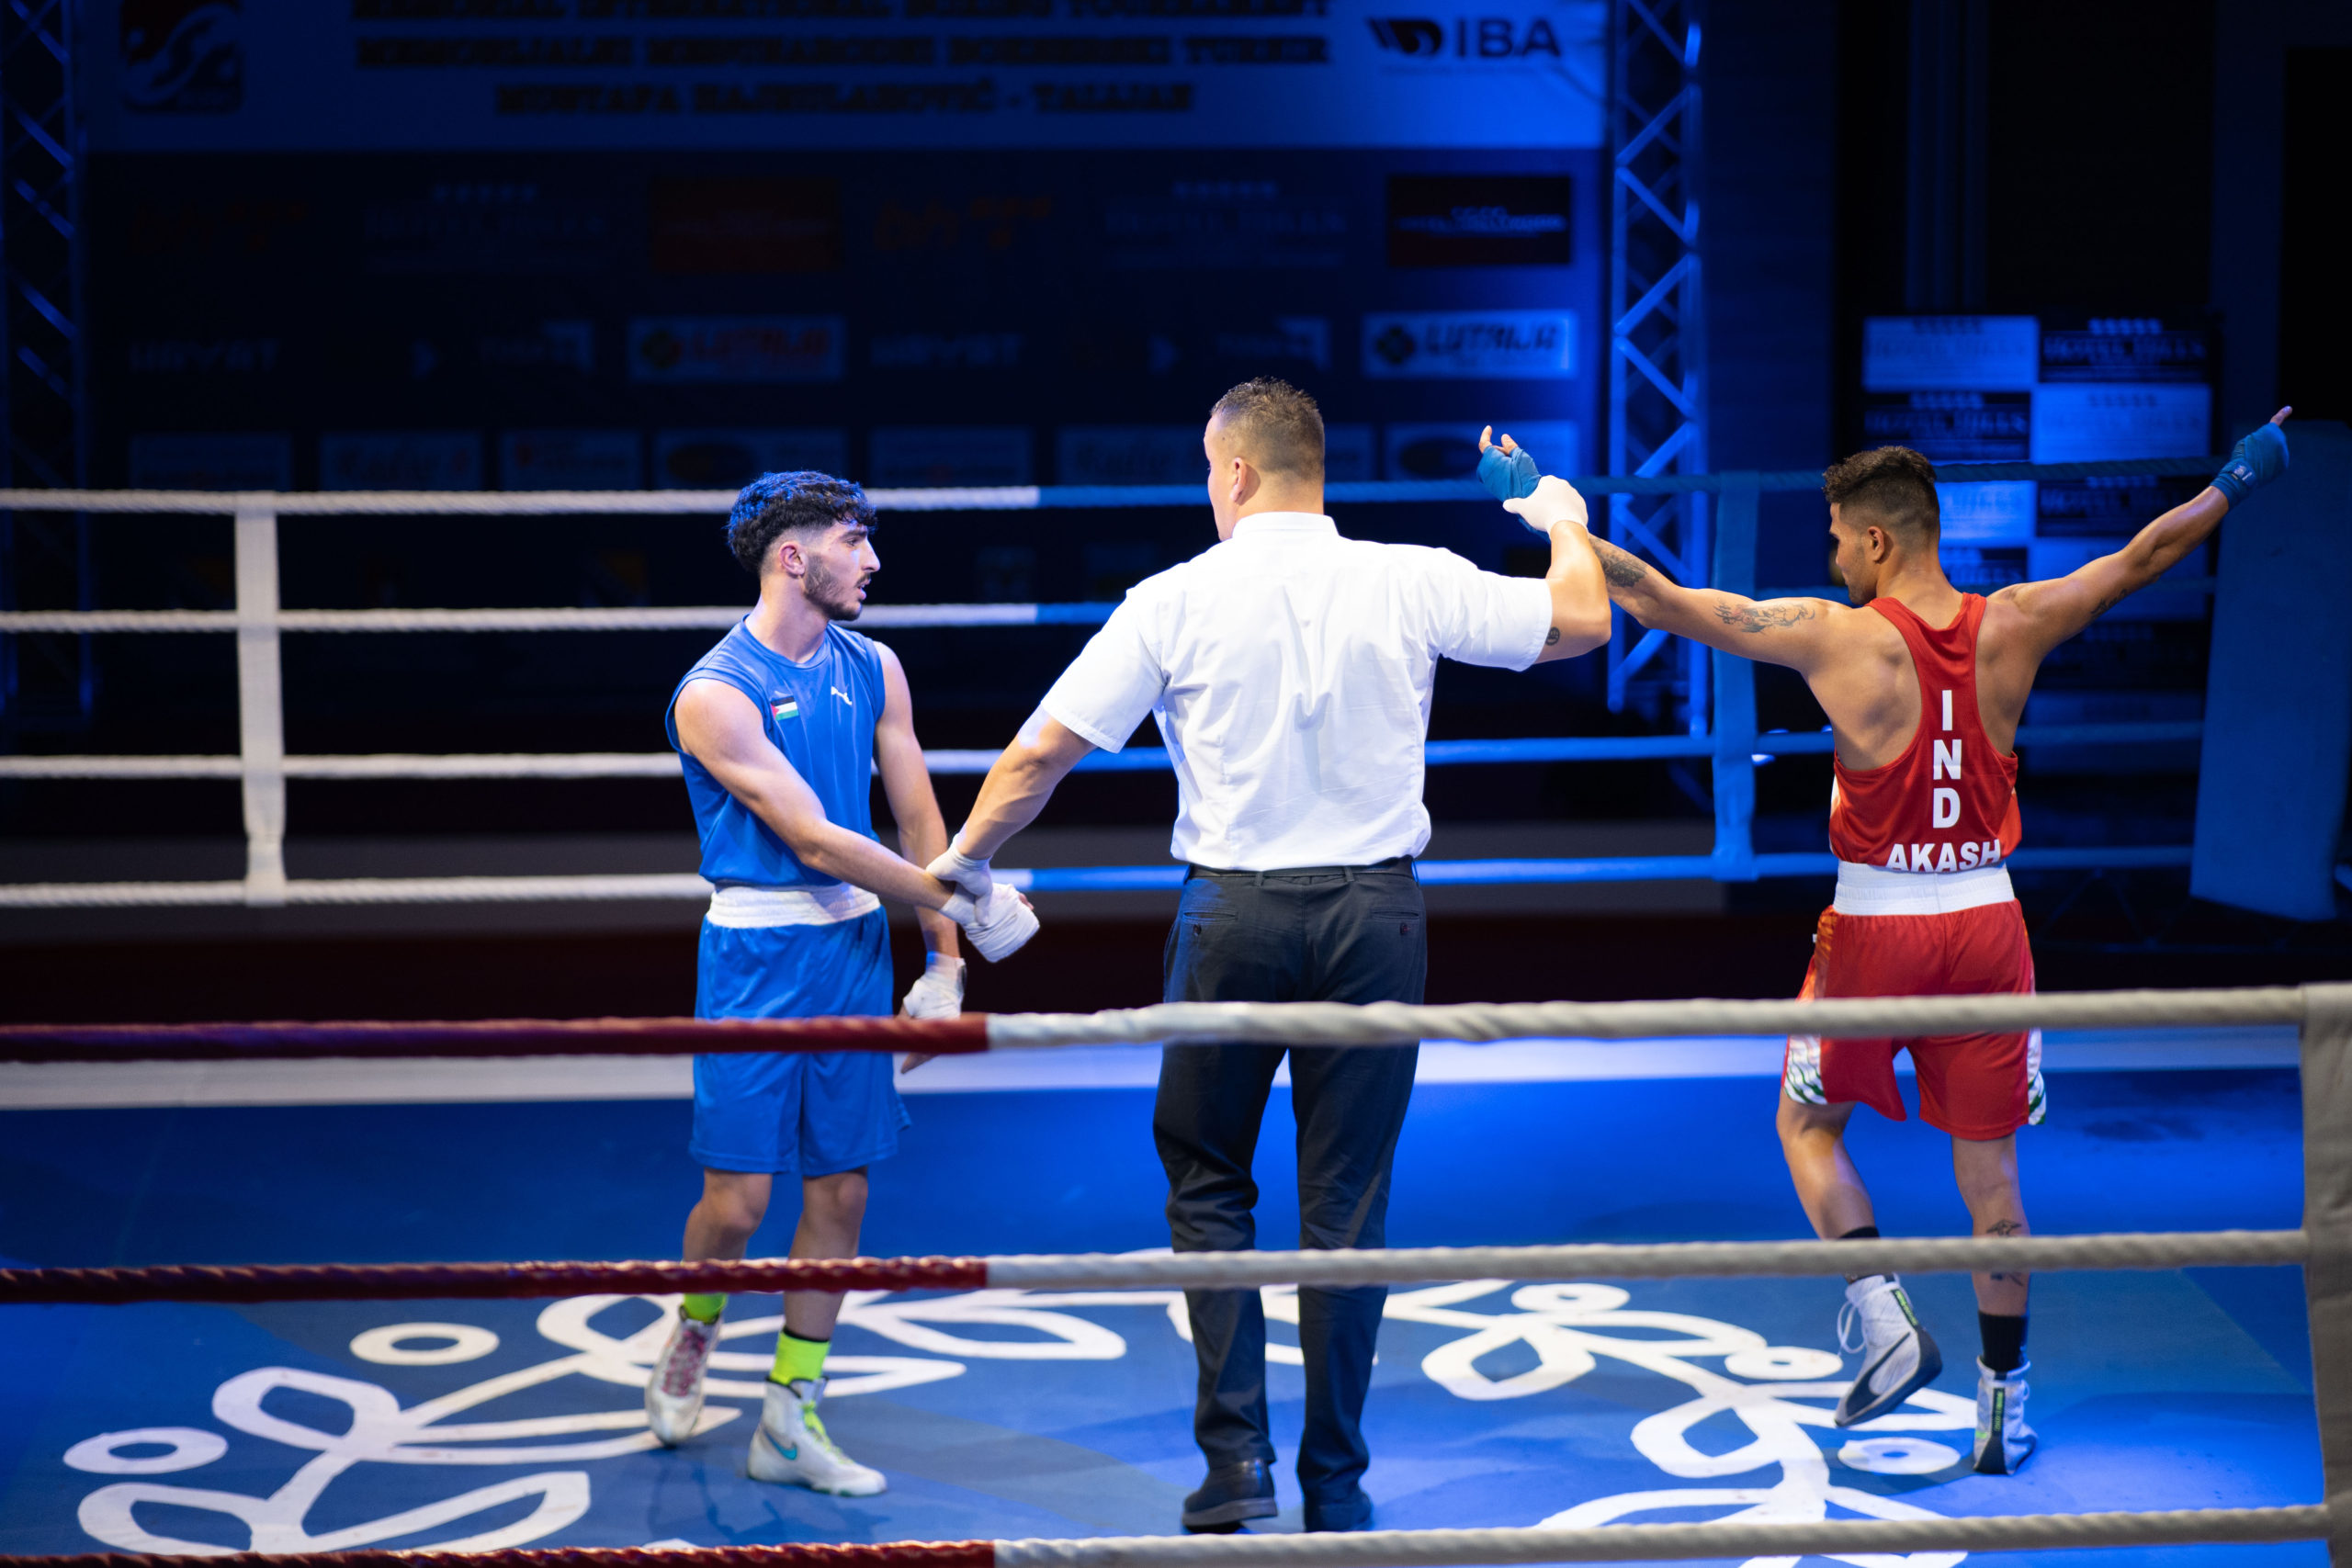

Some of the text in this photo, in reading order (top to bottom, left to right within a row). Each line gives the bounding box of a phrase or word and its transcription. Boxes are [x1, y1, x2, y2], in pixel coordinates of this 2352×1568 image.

[1456, 17, 1561, 58] IBA
[1932, 689, 1962, 829] IND
[1886, 838, 2002, 874] AKASH
